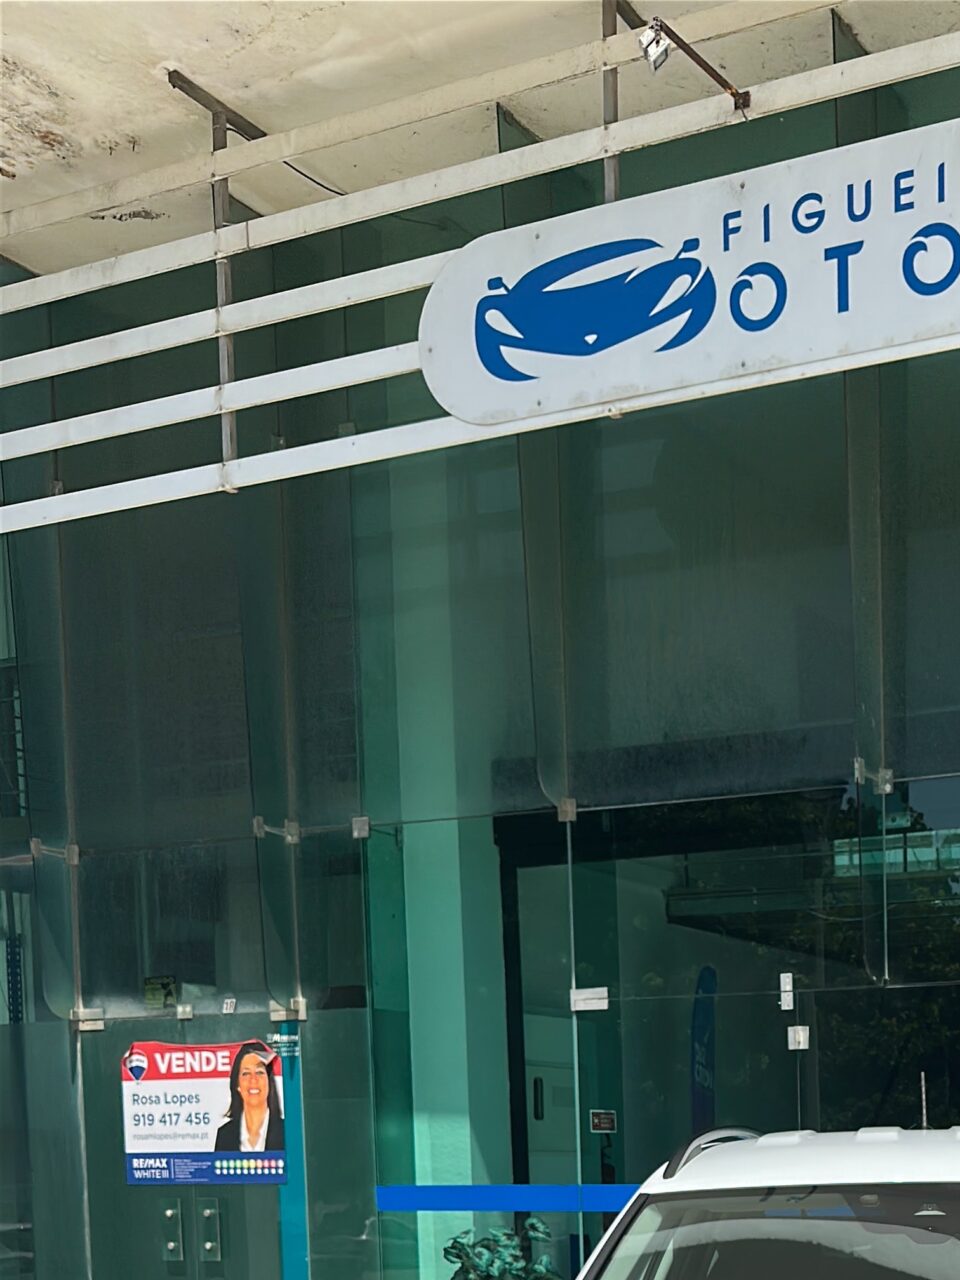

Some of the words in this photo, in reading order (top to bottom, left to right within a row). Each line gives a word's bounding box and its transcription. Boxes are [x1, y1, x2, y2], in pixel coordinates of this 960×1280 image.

[154, 1050, 231, 1075] VENDE
[132, 1093, 161, 1106] Rosa
[164, 1092, 201, 1106] Lopes
[133, 1113, 155, 1127] 919
[159, 1113, 181, 1126] 417
[185, 1112, 211, 1126] 456
[132, 1158, 168, 1169] RE/MAX
[133, 1169, 162, 1179] WHITE
